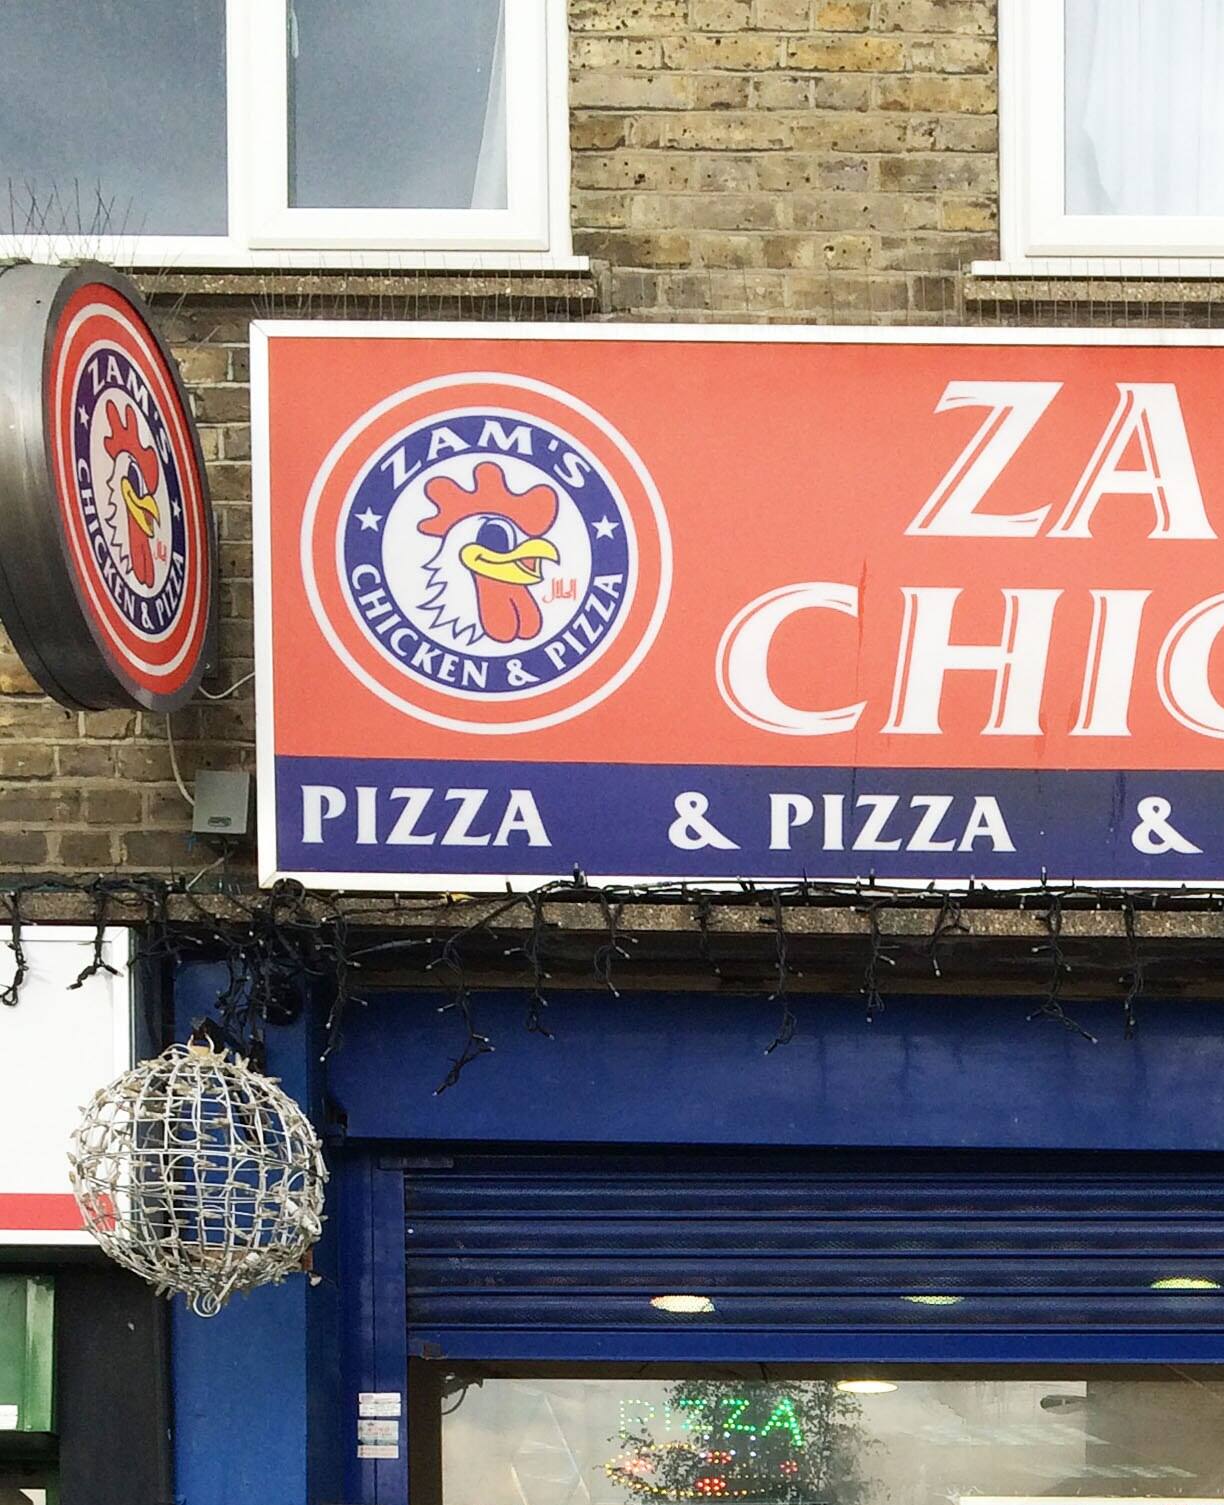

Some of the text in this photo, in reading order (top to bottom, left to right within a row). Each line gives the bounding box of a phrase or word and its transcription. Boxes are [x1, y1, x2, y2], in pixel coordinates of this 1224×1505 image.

[87, 354, 171, 461] ZAM'S
[380, 419, 592, 488] ZAM'S
[79, 457, 136, 623] CHICKEN
[140, 601, 155, 630] &
[156, 552, 186, 623] PIZZA
[352, 562, 624, 689] CHICKEN & PIZZA
[301, 784, 553, 849] PIZZA
[667, 791, 741, 851] &
[769, 793, 1016, 852] PIZZA
[1131, 796, 1204, 855] &
[619, 1398, 806, 1448] PIZZA
